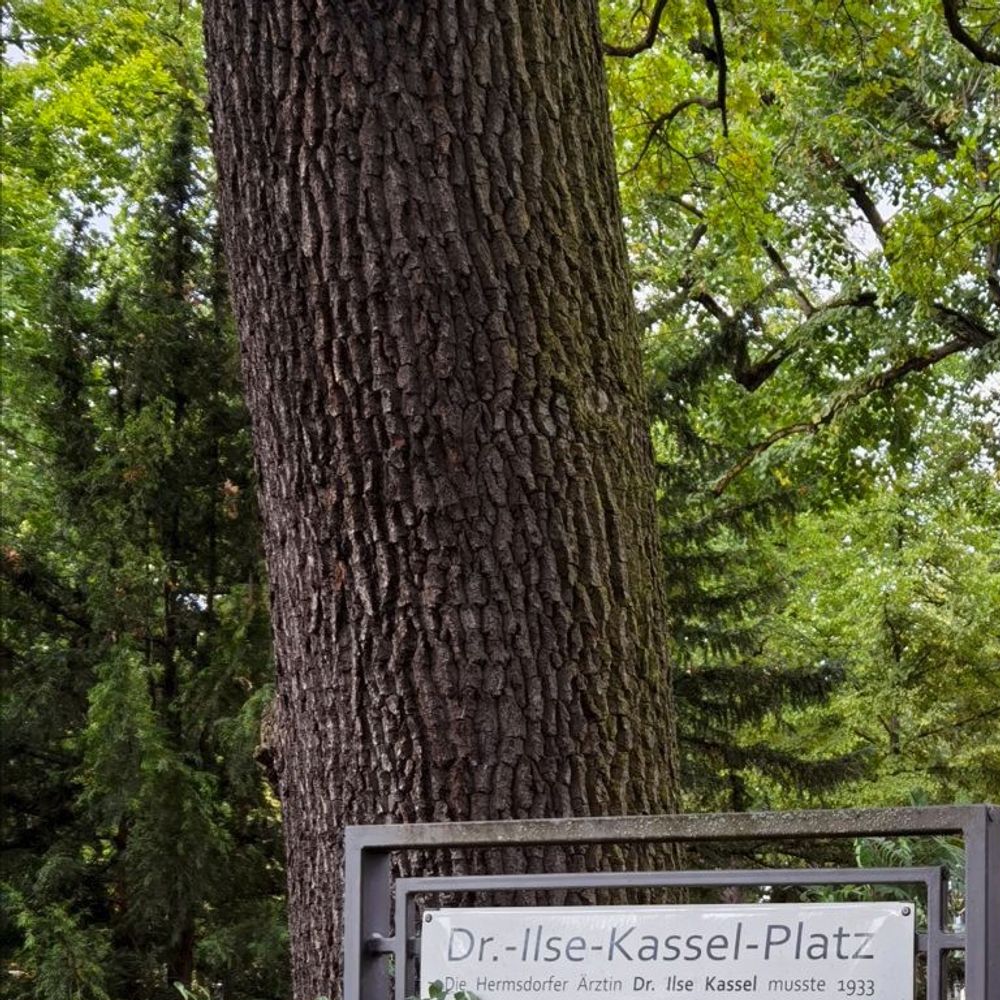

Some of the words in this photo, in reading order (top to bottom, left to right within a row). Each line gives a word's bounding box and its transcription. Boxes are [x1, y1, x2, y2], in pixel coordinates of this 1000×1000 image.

[448, 922, 874, 962] Dr.-Ilse-Kassel-Platz
[444, 977, 466, 993] Die
[477, 976, 568, 992] Hermsdorfer
[577, 974, 622, 992] Ärztin
[633, 976, 654, 991] Dr.
[666, 975, 694, 992] Ilse
[705, 975, 757, 992] Kassel
[768, 978, 826, 992] musste
[838, 980, 874, 996] 1933
